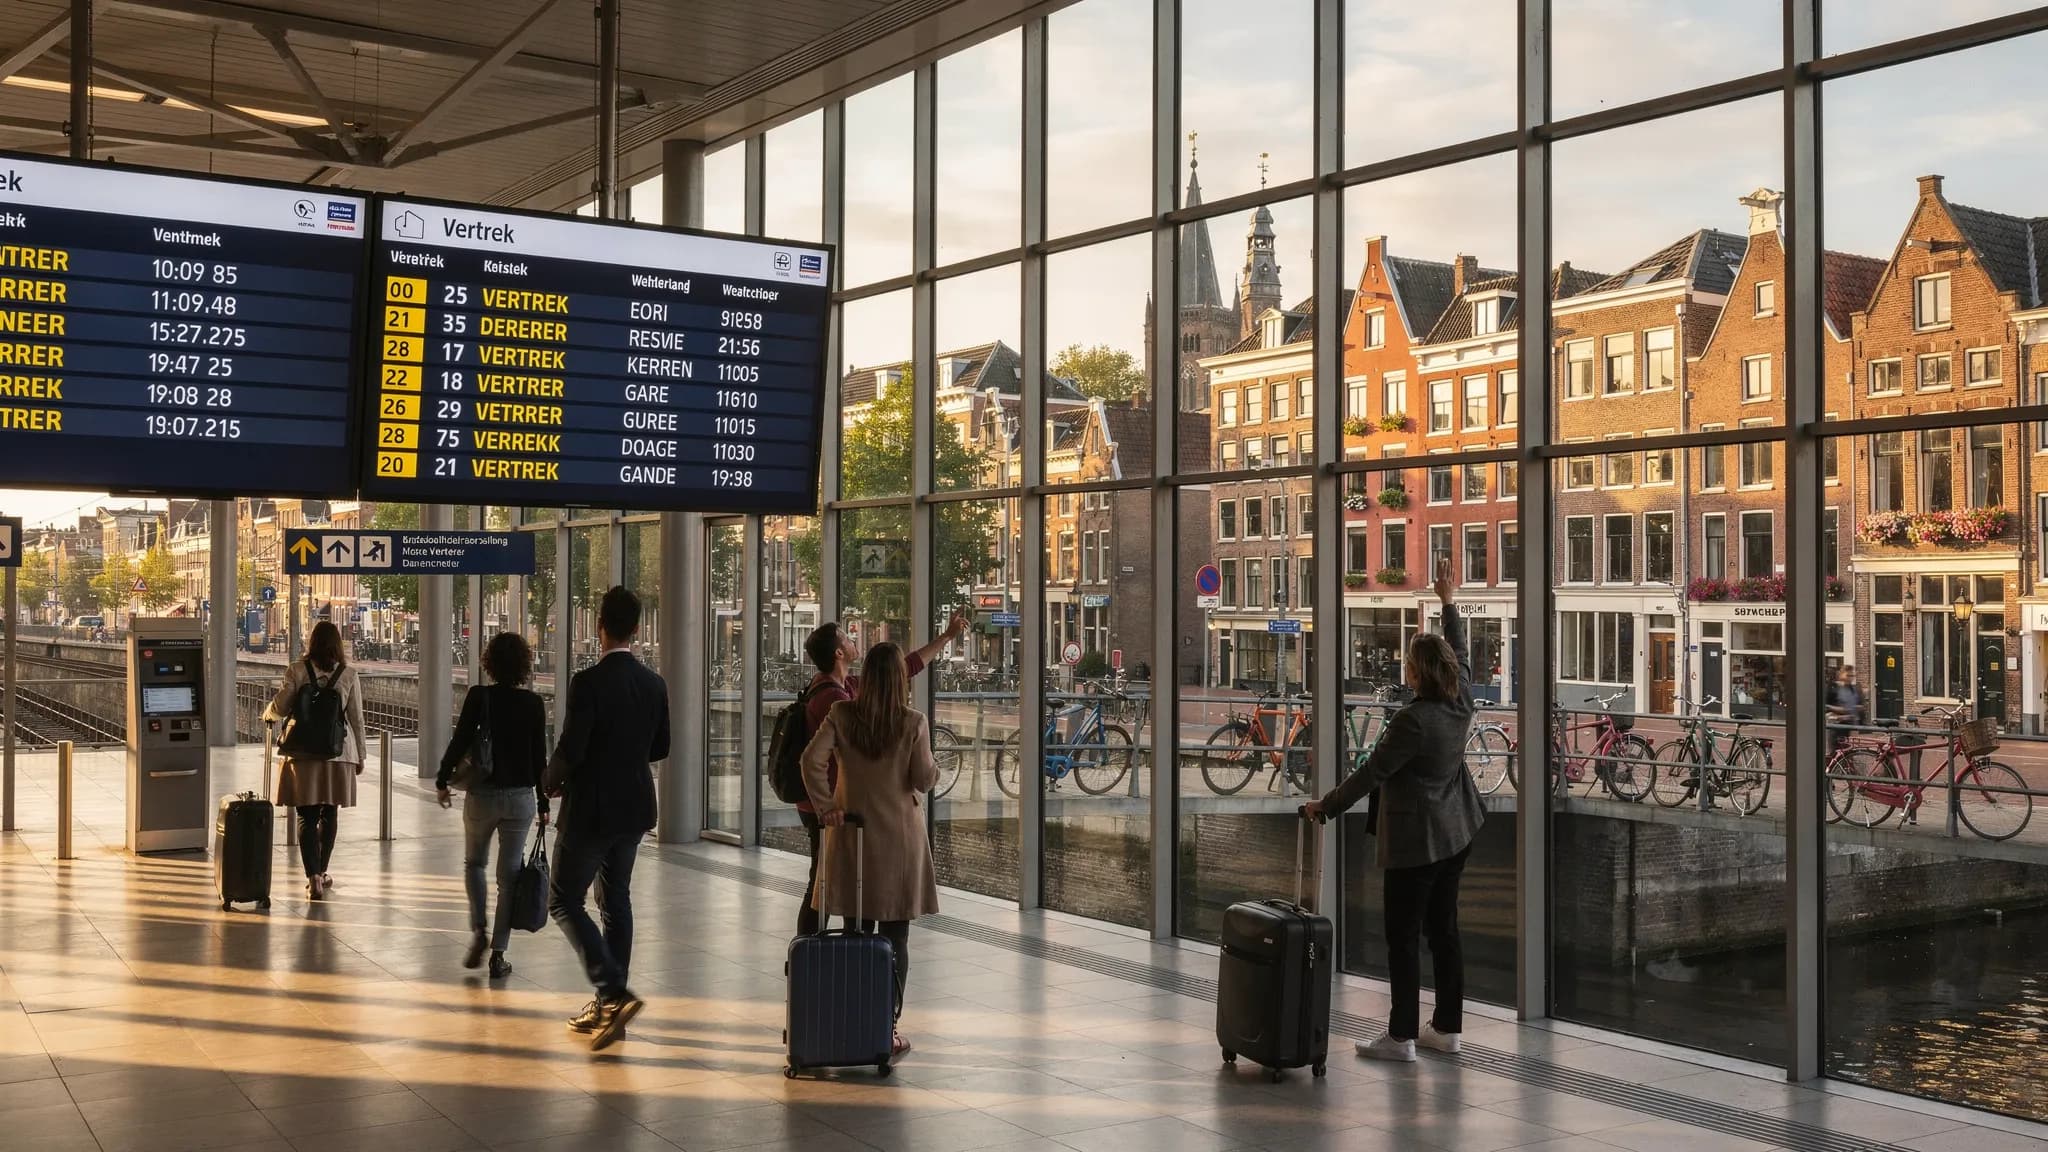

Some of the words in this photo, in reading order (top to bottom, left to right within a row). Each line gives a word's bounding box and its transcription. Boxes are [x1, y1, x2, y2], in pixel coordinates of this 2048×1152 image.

[443, 217, 514, 243] Vertrek
[153, 259, 205, 281] 10:09
[213, 265, 237, 284] 85
[390, 282, 413, 298] 00
[444, 285, 468, 305] 25
[482, 288, 569, 314] VERTREK
[630, 302, 668, 322] EORI
[388, 311, 409, 328] 21
[442, 314, 466, 333] 35
[480, 316, 568, 342] DERERER
[718, 337, 760, 356] 21:56
[149, 353, 200, 374] 19:47
[208, 357, 233, 377] 25
[387, 340, 409, 357] 28
[442, 343, 465, 362] 17
[479, 345, 566, 370] VERTREK
[627, 356, 693, 378] KERREN
[147, 384, 198, 405] 19:08
[206, 388, 232, 407] 28
[385, 369, 407, 386] 22
[441, 371, 463, 391] 18
[476, 373, 565, 397] VERTRER
[625, 384, 669, 403] GARE
[716, 390, 758, 409] 11610
[383, 398, 406, 416] 26
[437, 400, 461, 419] 29
[475, 402, 563, 425] VETRRER
[623, 411, 678, 431] GUREE
[715, 417, 756, 435] 11015
[382, 427, 405, 444] 28
[436, 429, 460, 448] 75
[473, 430, 561, 452] VERREKK
[621, 438, 677, 458] DOAGE
[713, 443, 755, 461] 11030
[381, 456, 403, 473] 20
[435, 457, 456, 476] 21
[471, 459, 559, 480] VERTREK
[620, 465, 676, 485] GANDE
